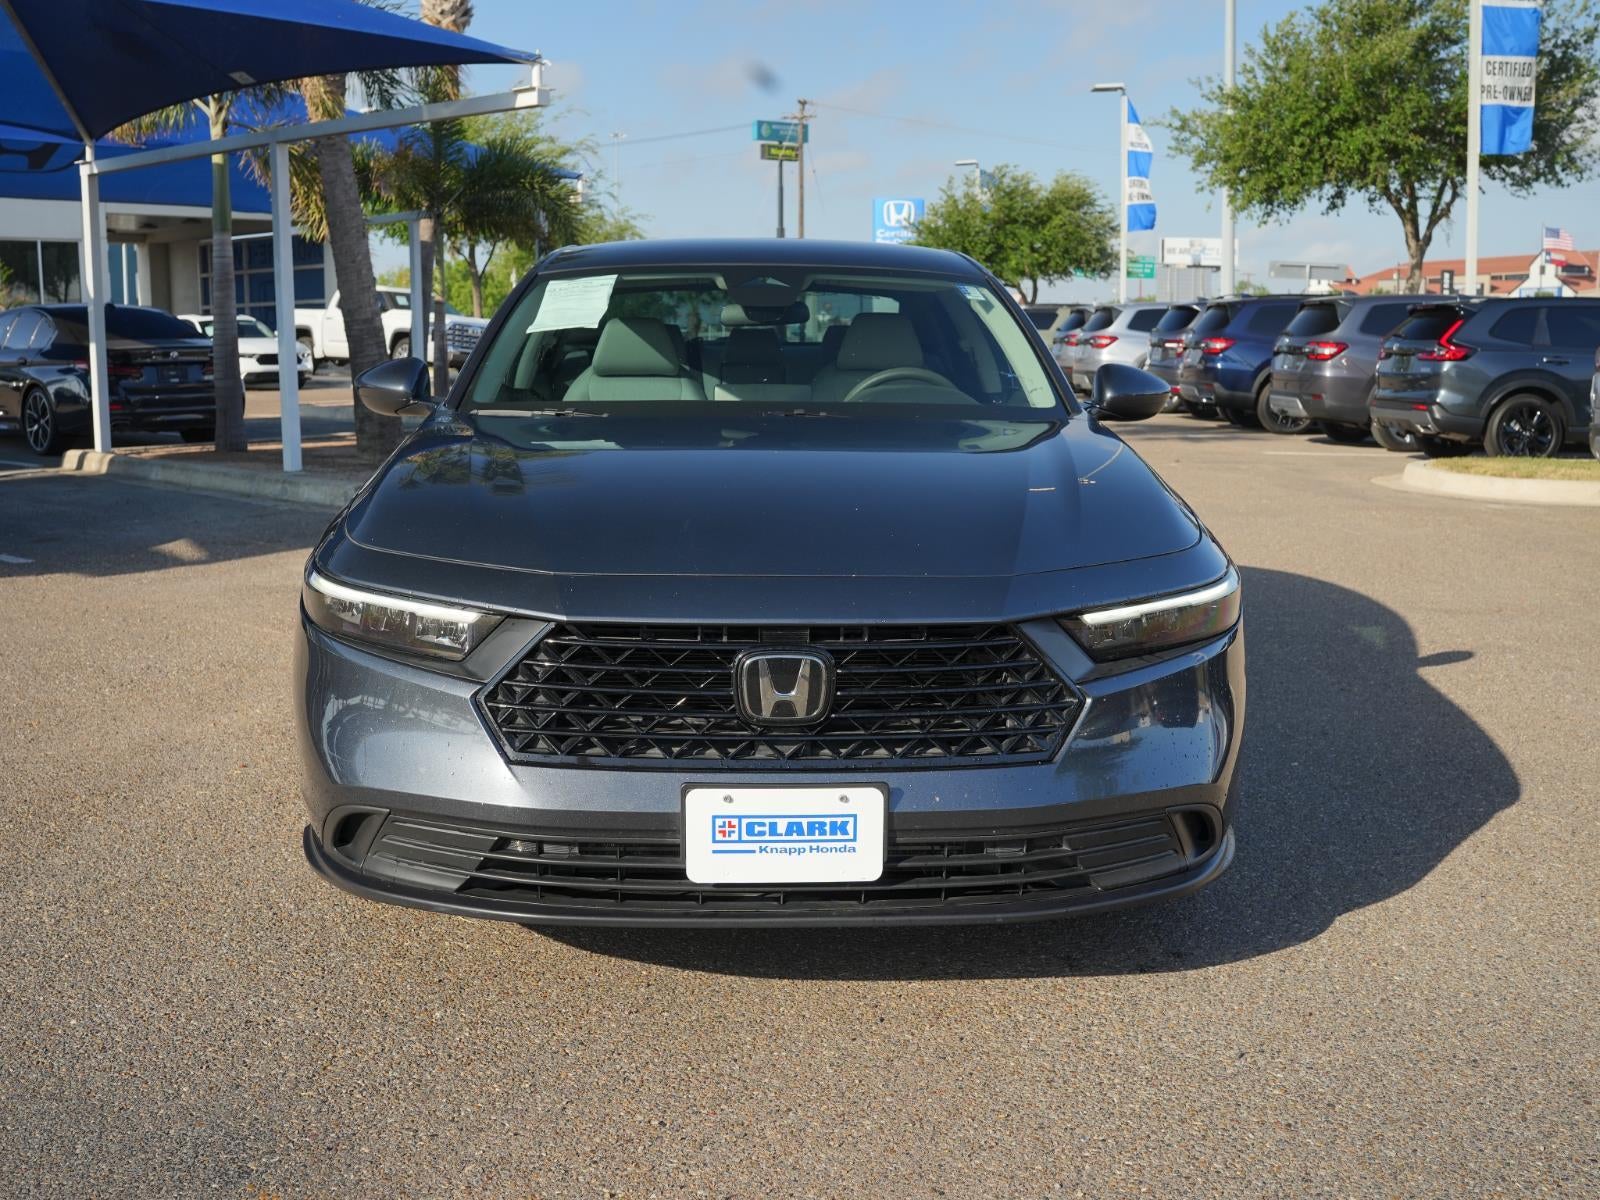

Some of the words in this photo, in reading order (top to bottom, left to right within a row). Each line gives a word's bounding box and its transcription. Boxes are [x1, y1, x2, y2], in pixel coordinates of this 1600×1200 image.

[1485, 61, 1533, 78] CERTIFIED
[1481, 84, 1533, 102] PRE-OWNED
[745, 820, 850, 837] CLARK
[758, 845, 807, 856] Knapp
[809, 845, 857, 854] Honda
